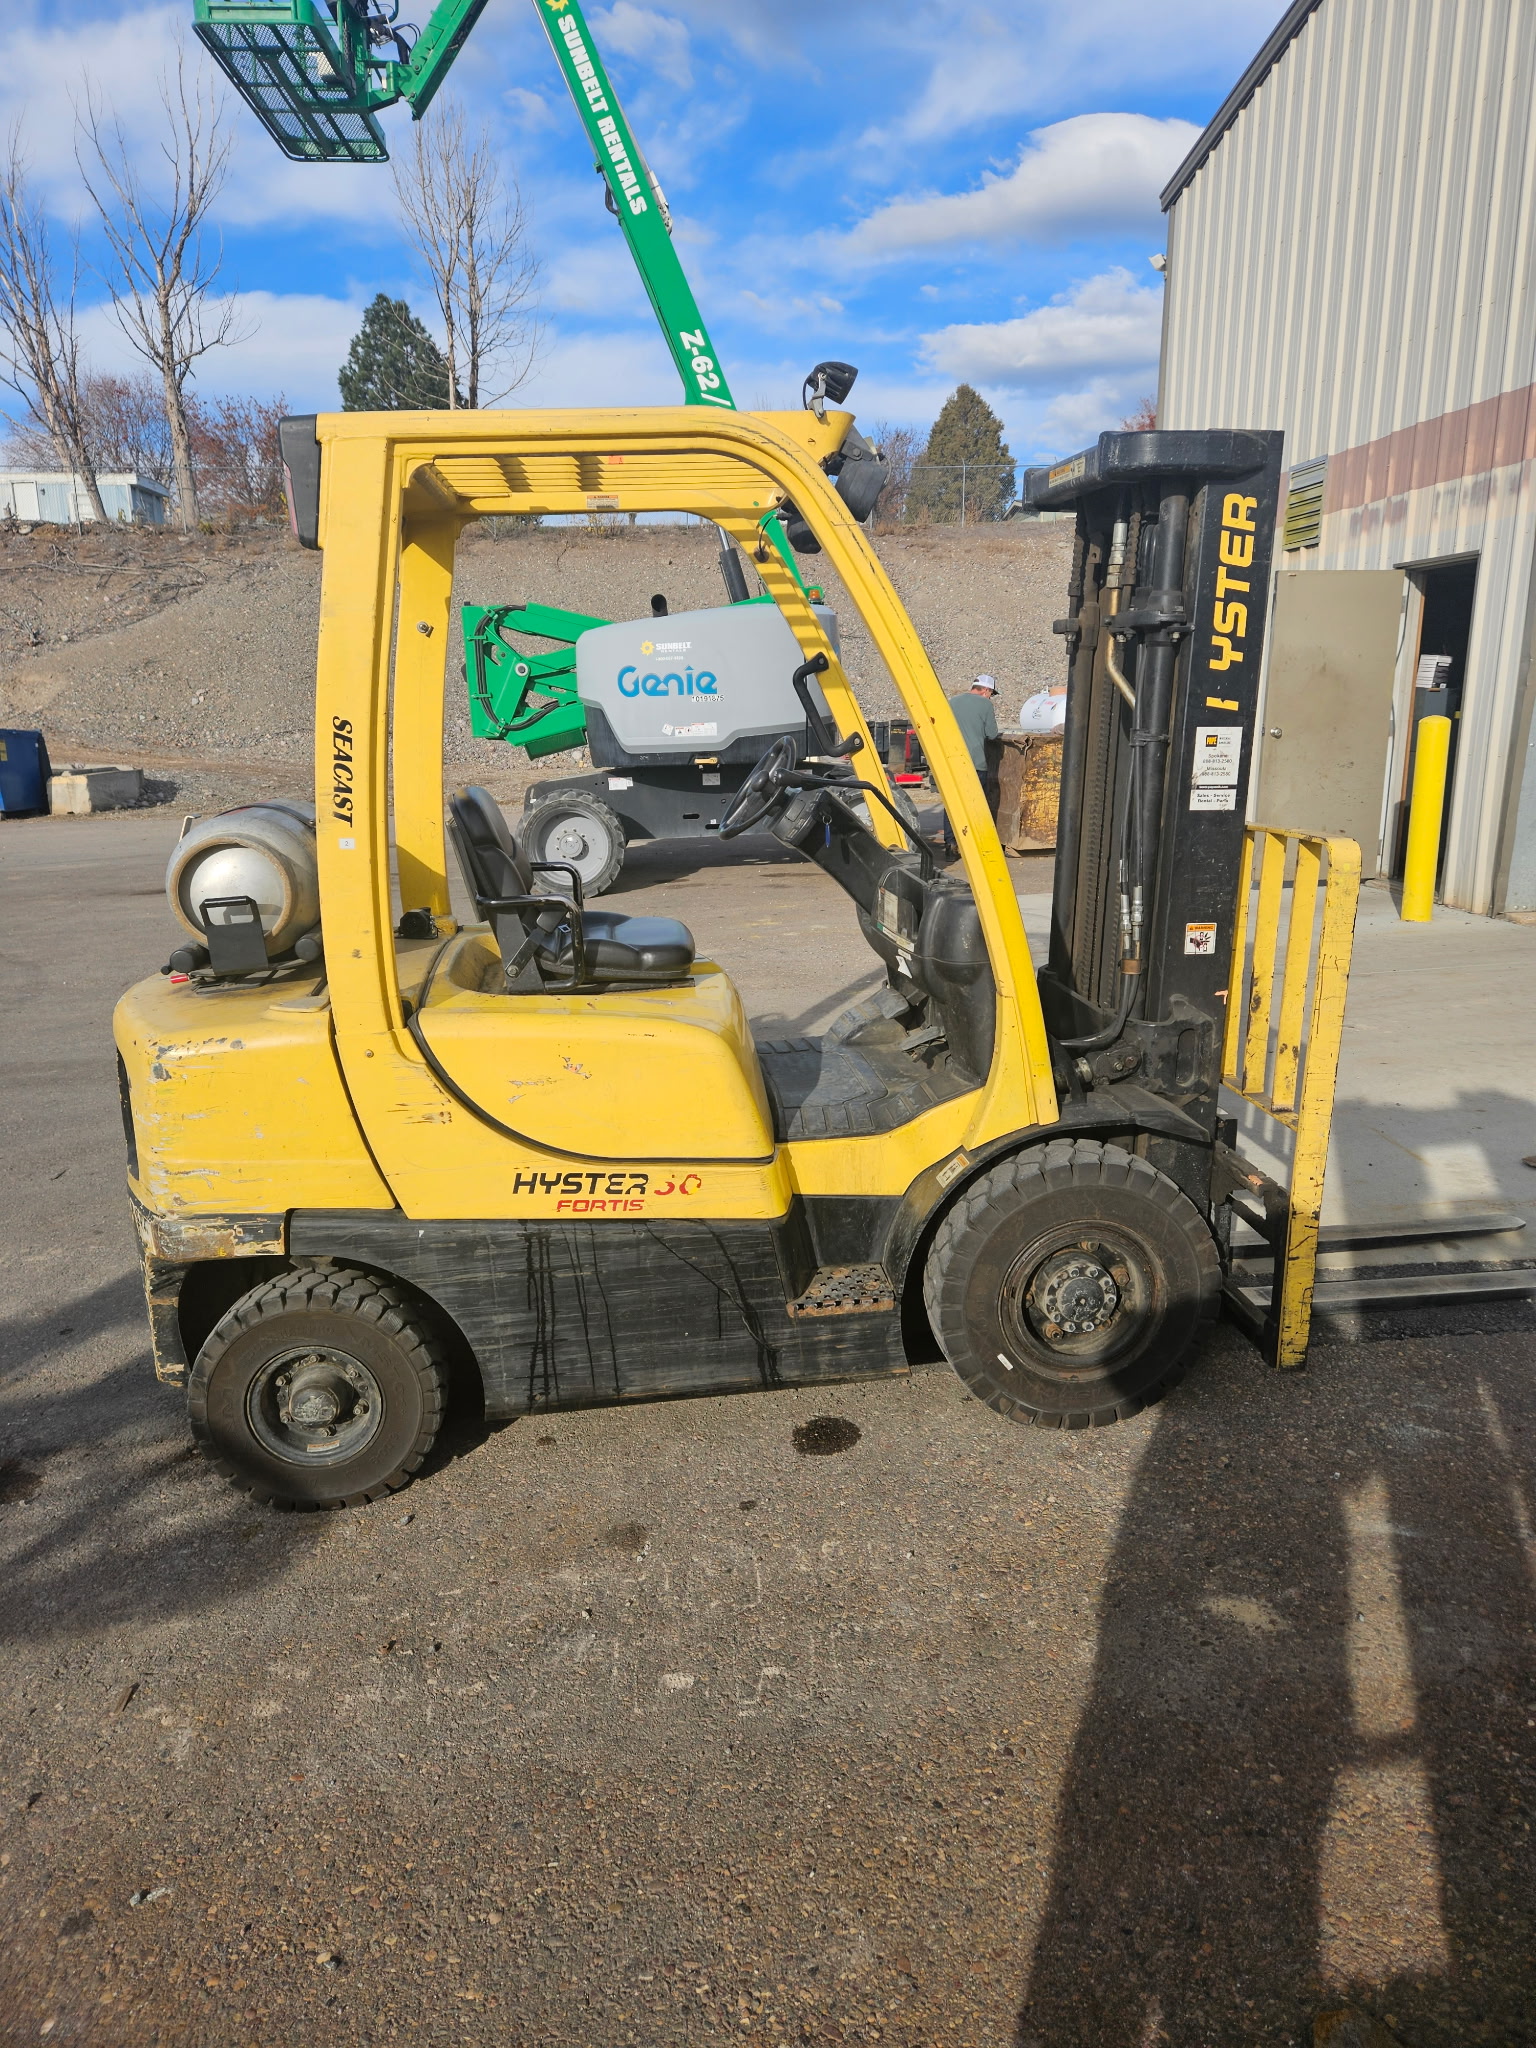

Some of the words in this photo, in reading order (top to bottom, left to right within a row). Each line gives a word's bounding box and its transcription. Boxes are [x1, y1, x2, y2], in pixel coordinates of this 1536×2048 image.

[558, 13, 609, 113] SUNBELT
[597, 115, 648, 216] RENTALS
[679, 328, 732, 407] Z-62/
[655, 642, 692, 650] SUNBELT
[618, 665, 717, 697] Genie
[332, 715, 354, 828] SEACAST
[512, 1172, 650, 1195] HYSTER
[555, 1199, 645, 1213] FORTIS
